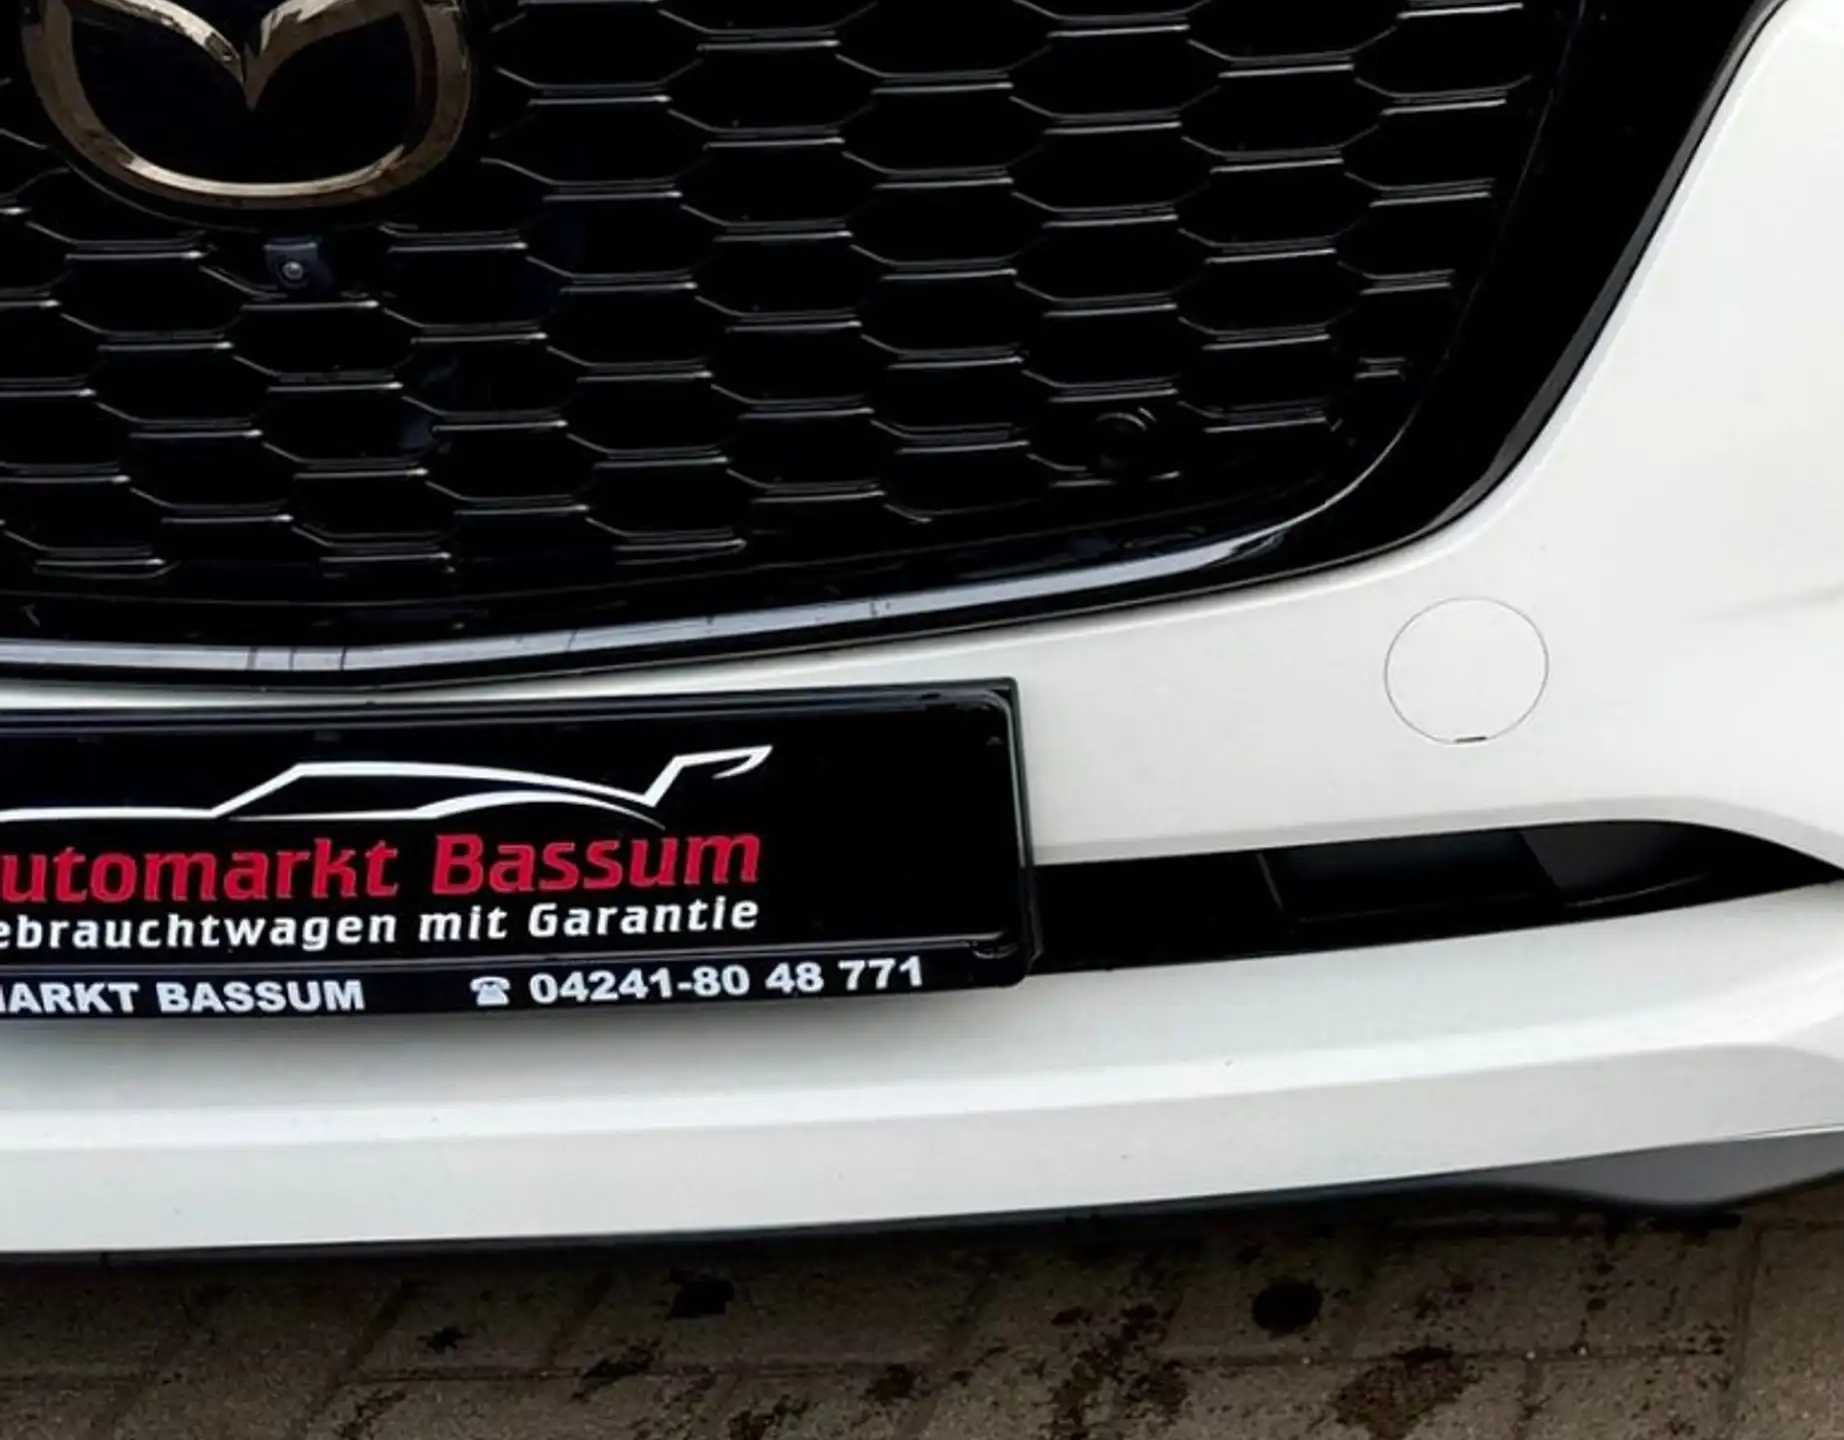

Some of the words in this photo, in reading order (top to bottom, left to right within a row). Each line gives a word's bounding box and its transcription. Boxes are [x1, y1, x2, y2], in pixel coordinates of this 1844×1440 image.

[431, 833, 761, 897] Bassum
[418, 904, 508, 942] mit
[528, 895, 760, 939] Garantie
[0, 981, 140, 1014] ARKT
[155, 979, 366, 1013] BASSUM
[529, 964, 751, 1004] 04241-80
[765, 961, 825, 994] 48
[838, 956, 925, 990] 771
